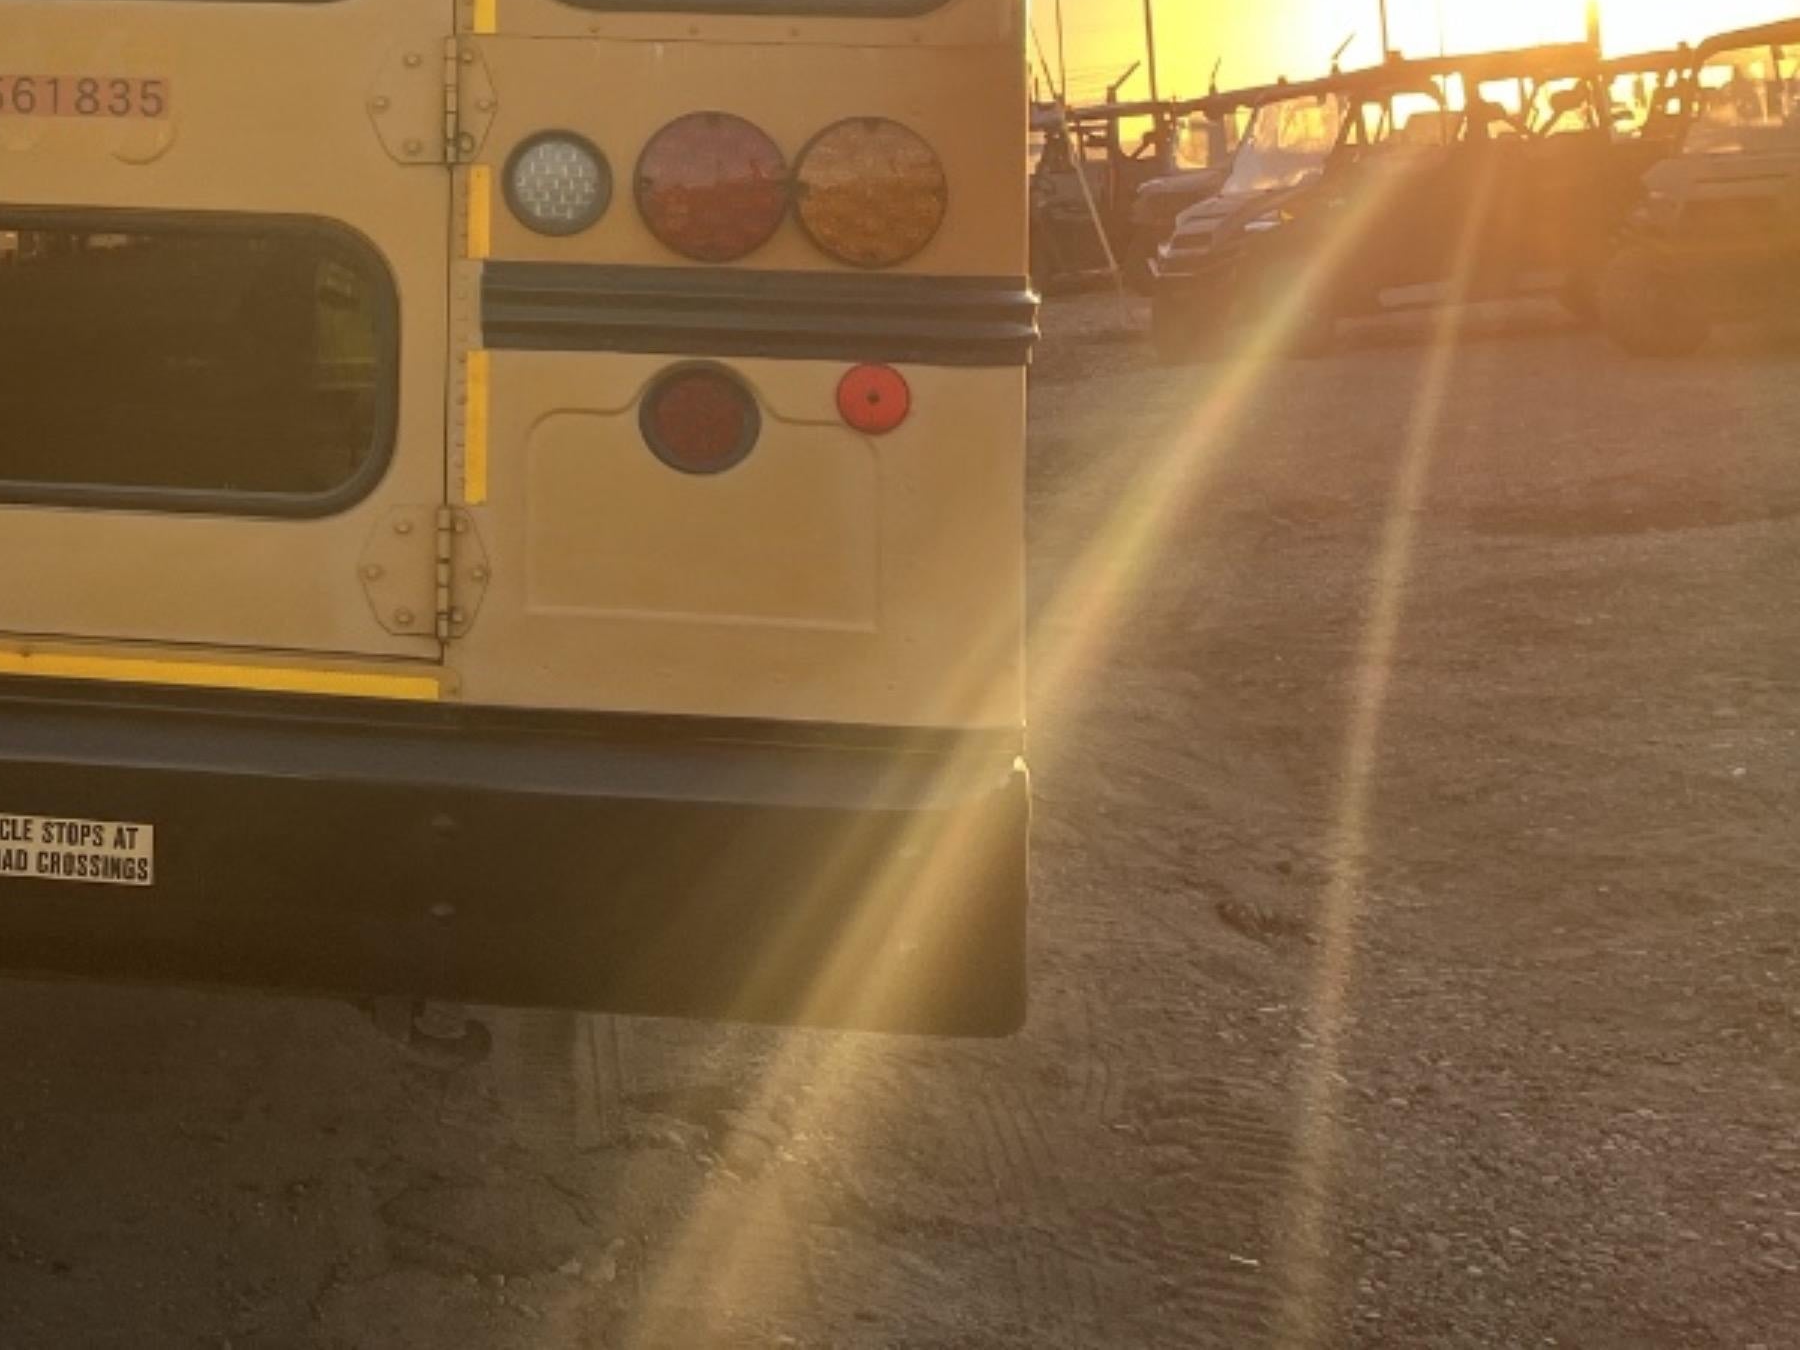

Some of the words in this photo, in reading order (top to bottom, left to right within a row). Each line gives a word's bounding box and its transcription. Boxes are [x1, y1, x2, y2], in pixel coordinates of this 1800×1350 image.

[41, 821, 104, 847] STOPS
[113, 827, 138, 850] AT
[36, 851, 148, 880] CROSSINGS
